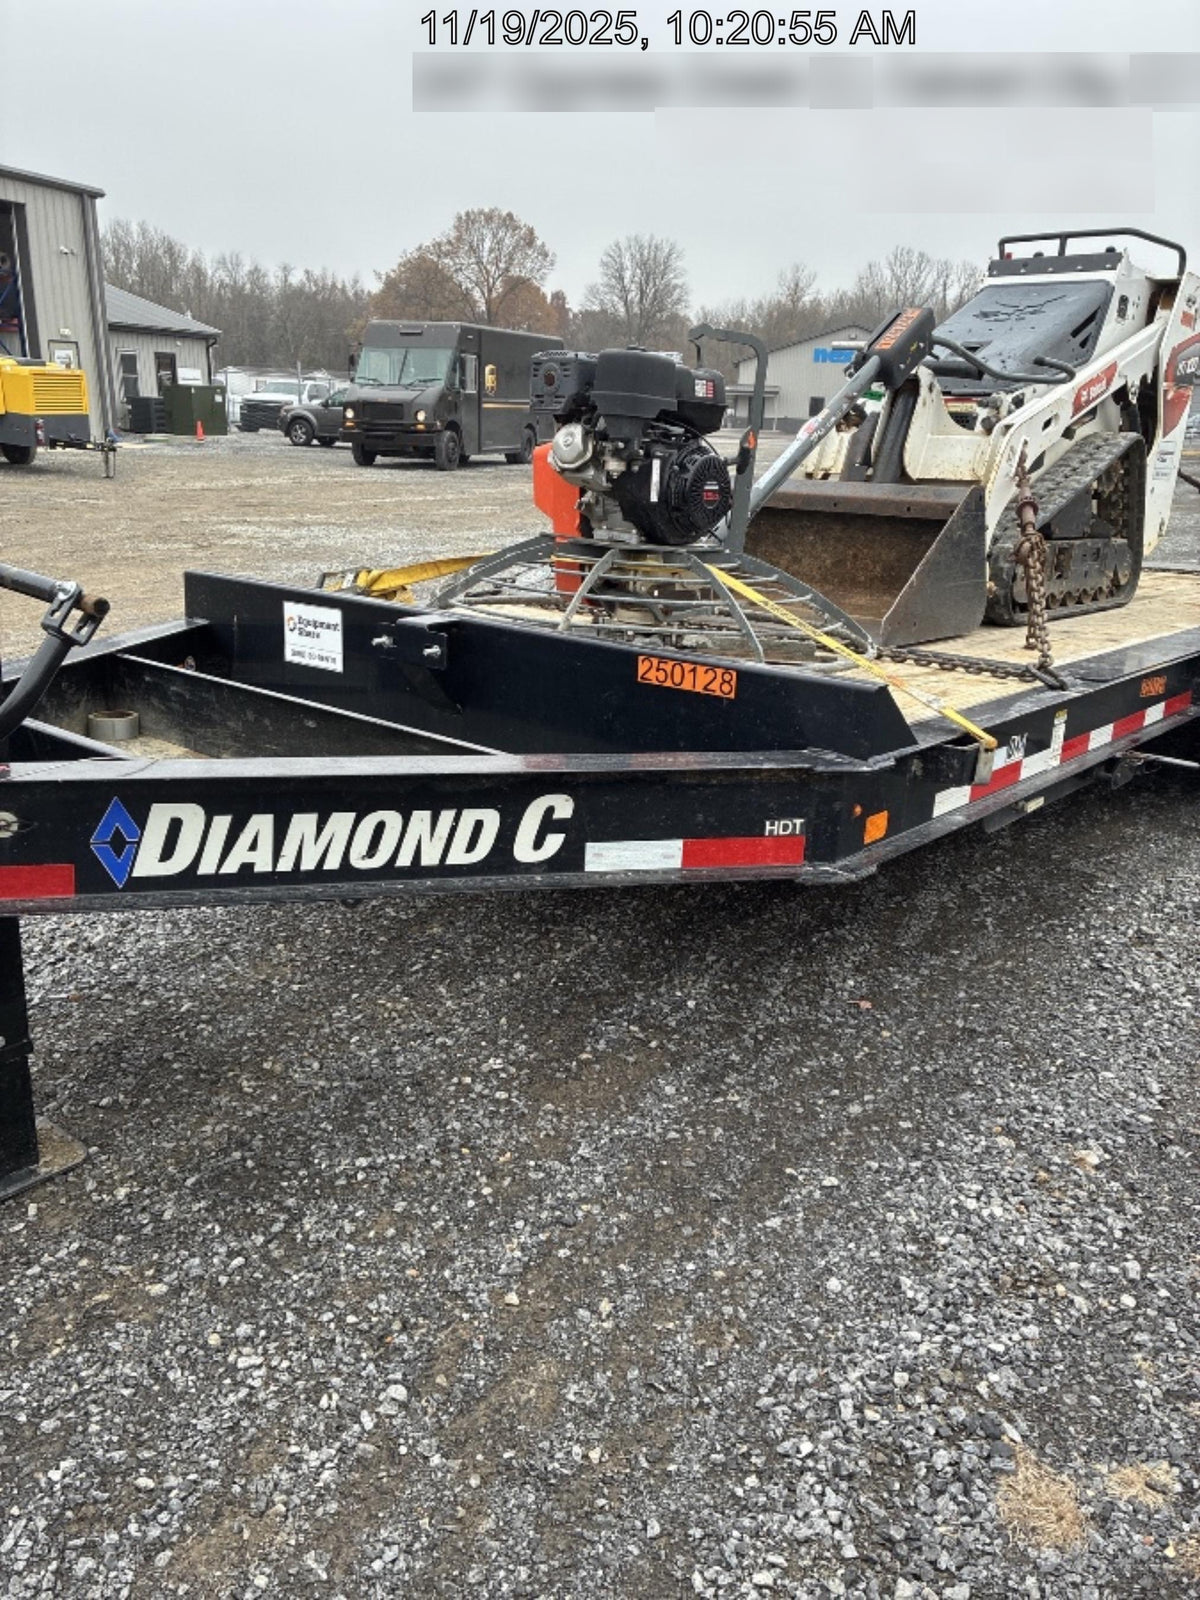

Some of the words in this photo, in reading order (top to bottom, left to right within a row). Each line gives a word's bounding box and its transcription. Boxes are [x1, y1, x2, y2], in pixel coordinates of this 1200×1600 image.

[639, 657, 734, 696] 250128
[513, 793, 575, 863] C
[764, 818, 806, 836] HDT
